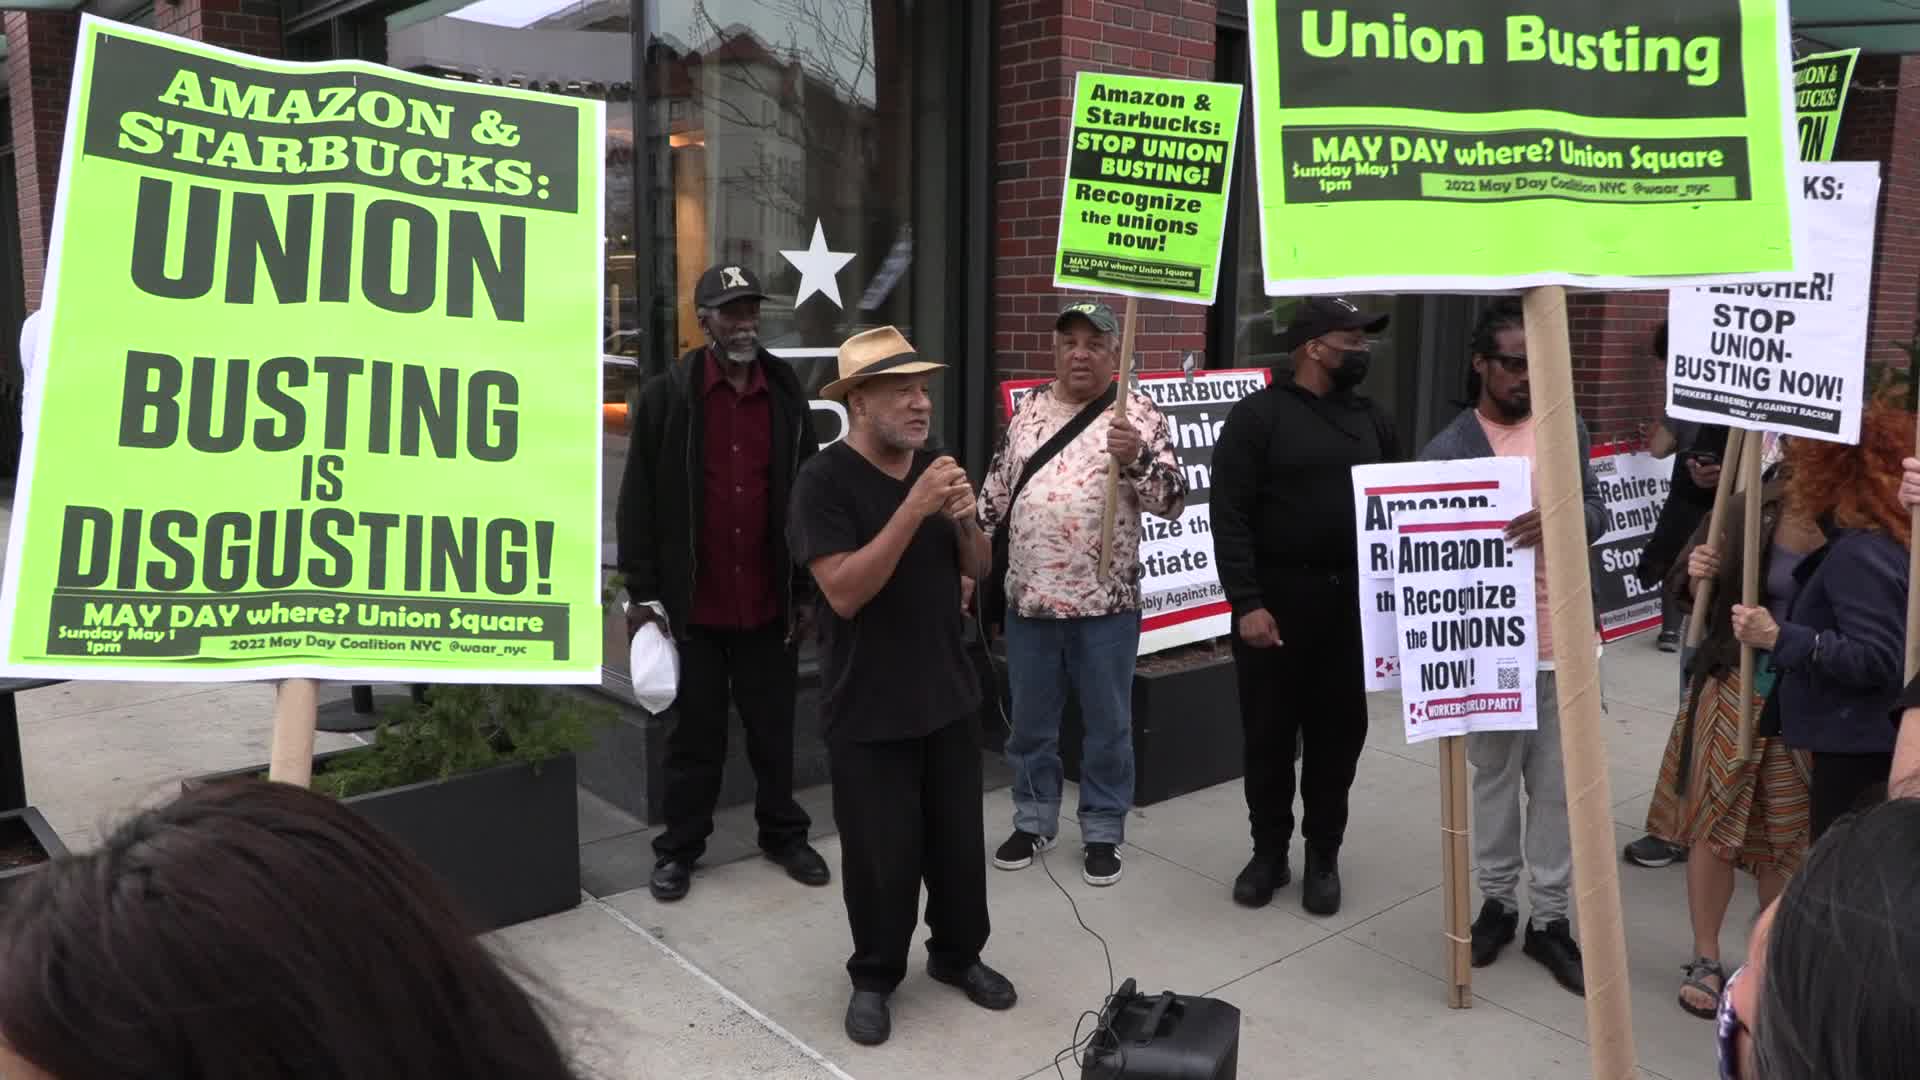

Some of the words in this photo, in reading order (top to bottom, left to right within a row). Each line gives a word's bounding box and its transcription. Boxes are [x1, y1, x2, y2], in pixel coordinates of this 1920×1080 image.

[1301, 10, 1484, 65] Union
[1506, 15, 1721, 87] Busting
[1794, 65, 1829, 86] ON
[158, 69, 455, 139] AMAZON
[471, 109, 521, 148] &
[1090, 84, 1186, 109] Amazon
[1193, 93, 1212, 111] &
[1796, 88, 1838, 108] UCKS:
[1086, 106, 1221, 136] Starbucks:
[118, 111, 550, 200] STARBUCKS:
[1075, 131, 1137, 155] STOP
[1141, 138, 1224, 164] UNION
[1312, 136, 1385, 163] MAY
[1390, 137, 1449, 164] DAY
[1454, 137, 1553, 167] where?
[1559, 141, 1623, 169] Union
[1629, 143, 1723, 172] Square
[1100, 157, 1211, 186] BUSTING!
[1292, 161, 1352, 179] Sunday
[1355, 162, 1389, 179] May
[1390, 163, 1399, 176] 1
[1075, 183, 1202, 214] Recognize
[1318, 178, 1353, 194] 1pm
[1445, 178, 1476, 192] 2022
[1479, 177, 1512, 194] May
[1515, 176, 1548, 192] Day
[1551, 177, 1597, 193] Coalition
[1599, 180, 1626, 195] NYC
[1081, 210, 1112, 226] the
[1116, 212, 1199, 236] unions
[130, 175, 527, 323] UNION
[1107, 230, 1167, 252] now!
[1069, 257, 1090, 266] MAY
[1091, 259, 1109, 268] DAY
[1110, 262, 1137, 273] where?
[1139, 265, 1163, 275] Union
[1165, 267, 1194, 279] Square
[1713, 303, 1796, 334] STOP
[1710, 331, 1793, 363] UNION-
[1674, 354, 1770, 391] BUSTING
[1779, 369, 1844, 402] NOW!
[118, 349, 520, 463] BUSTING
[1673, 385, 1713, 401] WORKERS
[1713, 393, 1754, 410] ASSEMBLY
[1756, 401, 1798, 415] AGAINST
[1799, 407, 1834, 421] RACISM
[301, 454, 345, 502] IS
[1600, 475, 1657, 504] Rehire
[56, 504, 555, 596] DISGUSTING!
[1398, 536, 1513, 574] Amazon:
[1165, 585, 1208, 607] Against
[1402, 580, 1517, 617] Recognize
[83, 602, 163, 628] MAY
[169, 604, 240, 628] DAY
[246, 602, 350, 626] where?
[357, 604, 442, 629] Union
[449, 607, 544, 634] Square
[58, 625, 124, 642] Sunday
[127, 626, 165, 643] May
[169, 629, 176, 641] 1
[86, 640, 122, 655] 1pm
[229, 639, 266, 651] 2022
[269, 636, 302, 649] May
[306, 635, 337, 650] Day
[339, 638, 406, 651] Coalition
[410, 640, 442, 652] NYC
[448, 641, 527, 656] @waar_nyc
[1405, 628, 1428, 650] the
[1420, 657, 1475, 692] NOW!
[1488, 697, 1520, 712] PARTY
